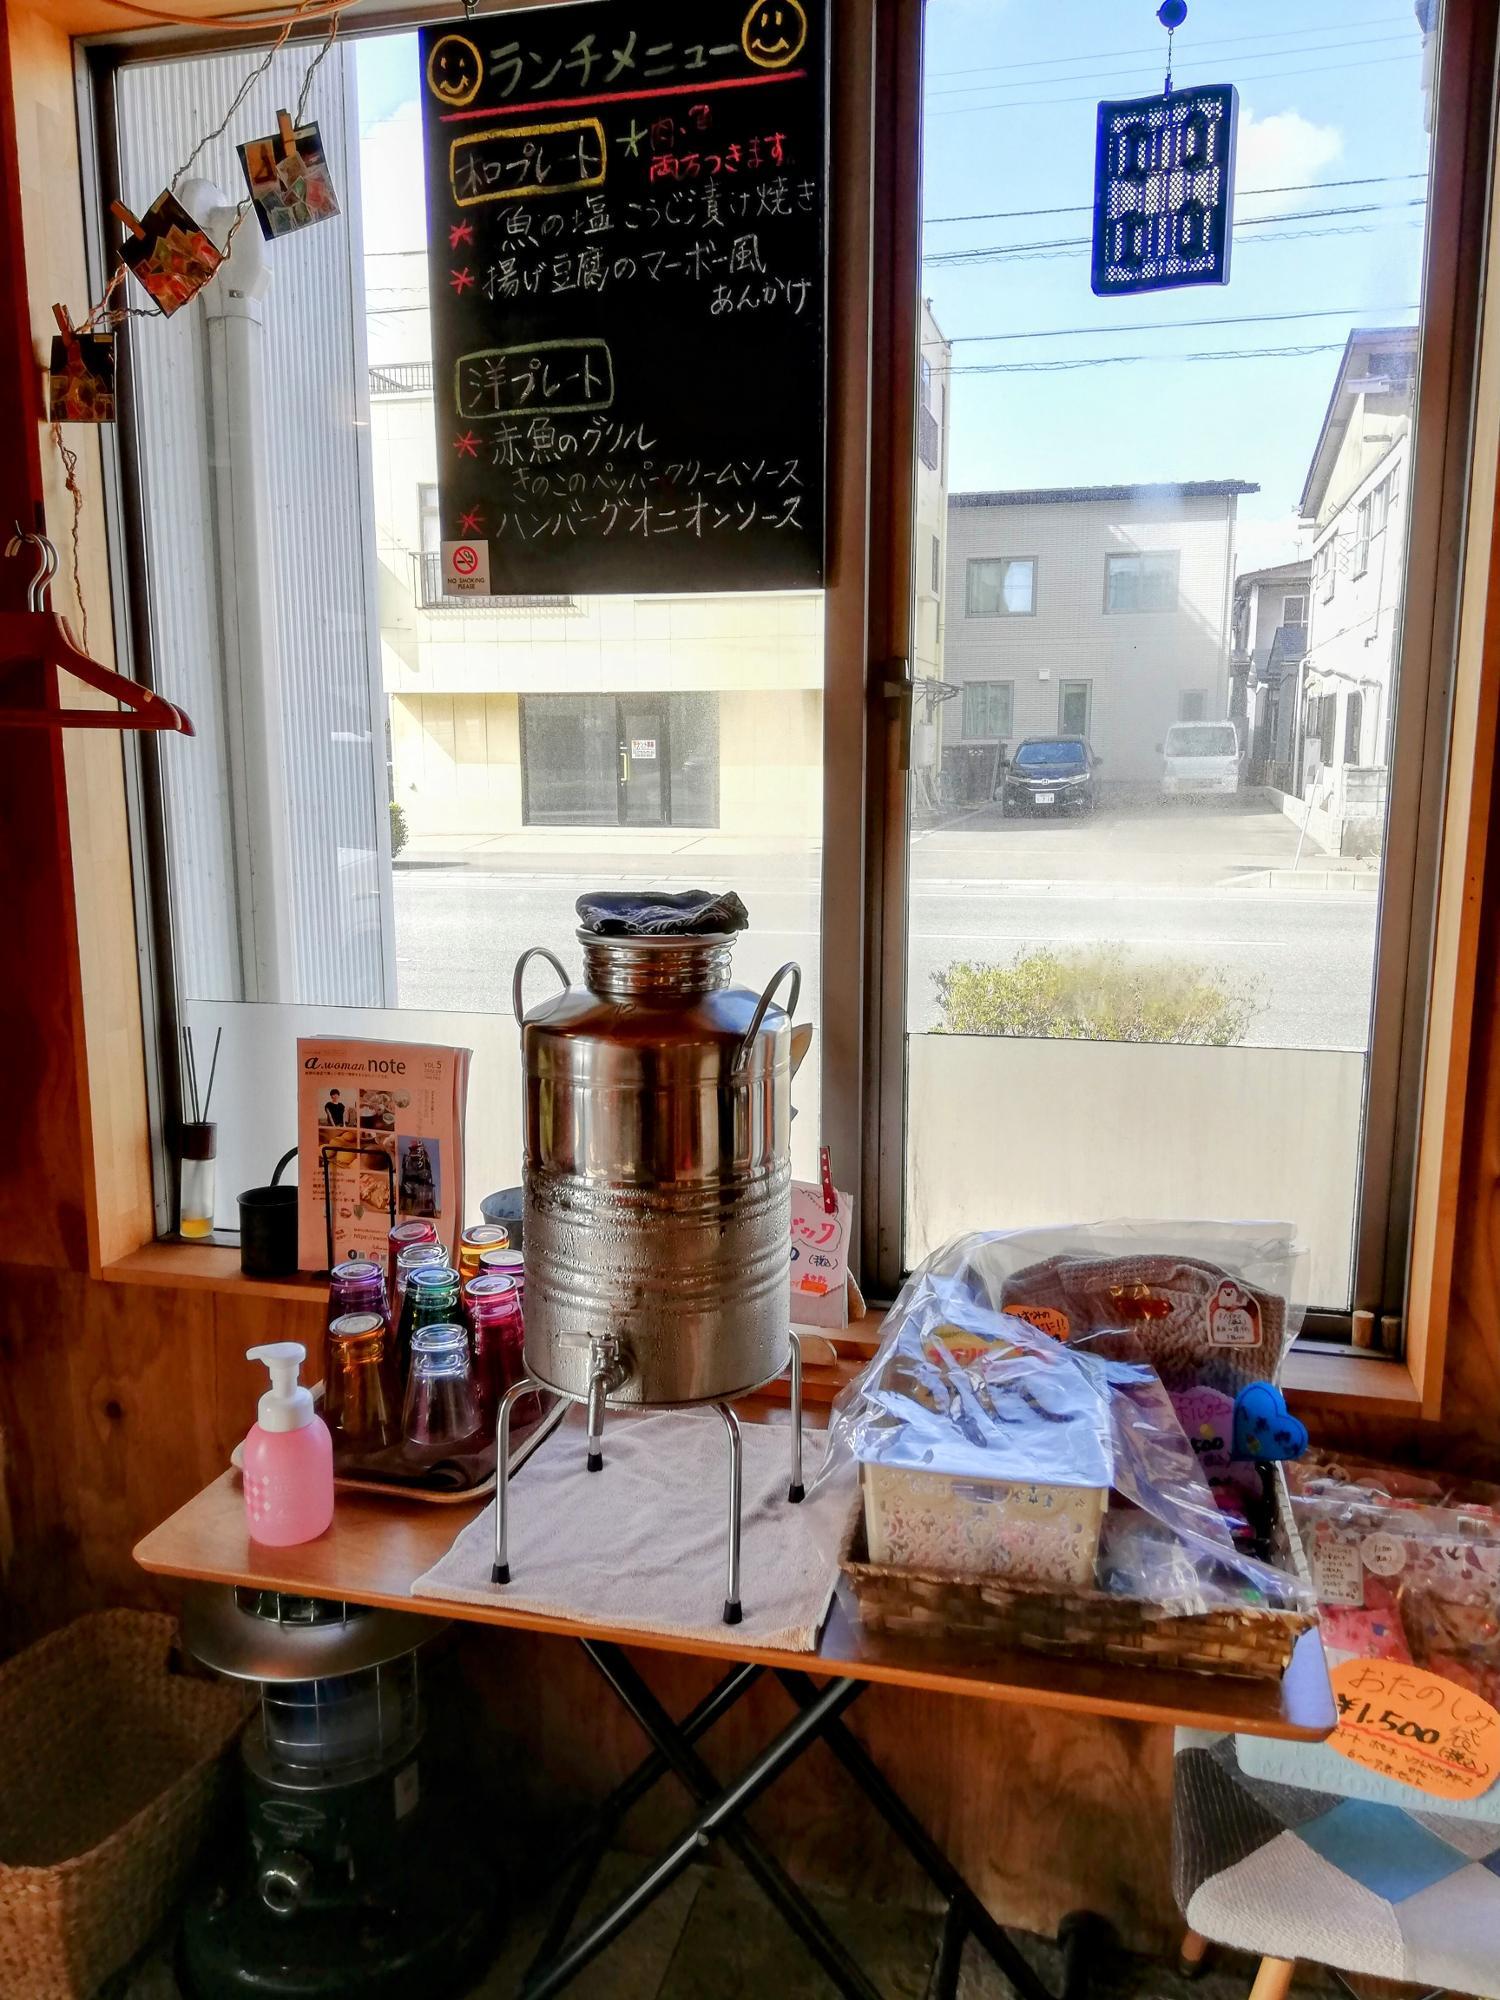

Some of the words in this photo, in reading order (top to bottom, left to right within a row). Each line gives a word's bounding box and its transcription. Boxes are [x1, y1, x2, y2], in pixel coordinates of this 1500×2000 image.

[489, 30, 739, 97] ランチメニュー
[456, 136, 602, 195] 和プレート
[650, 132, 786, 183] 両方つきます
[482, 233, 767, 301] 揚げ豆腐のマーボー風
[710, 276, 812, 315] あんかけ
[468, 353, 603, 409] 洋プレート
[491, 416, 658, 466] 赤魚のグリル
[368, 1059, 406, 1075] note
[1348, 1667, 1497, 1731] おたのしみ
